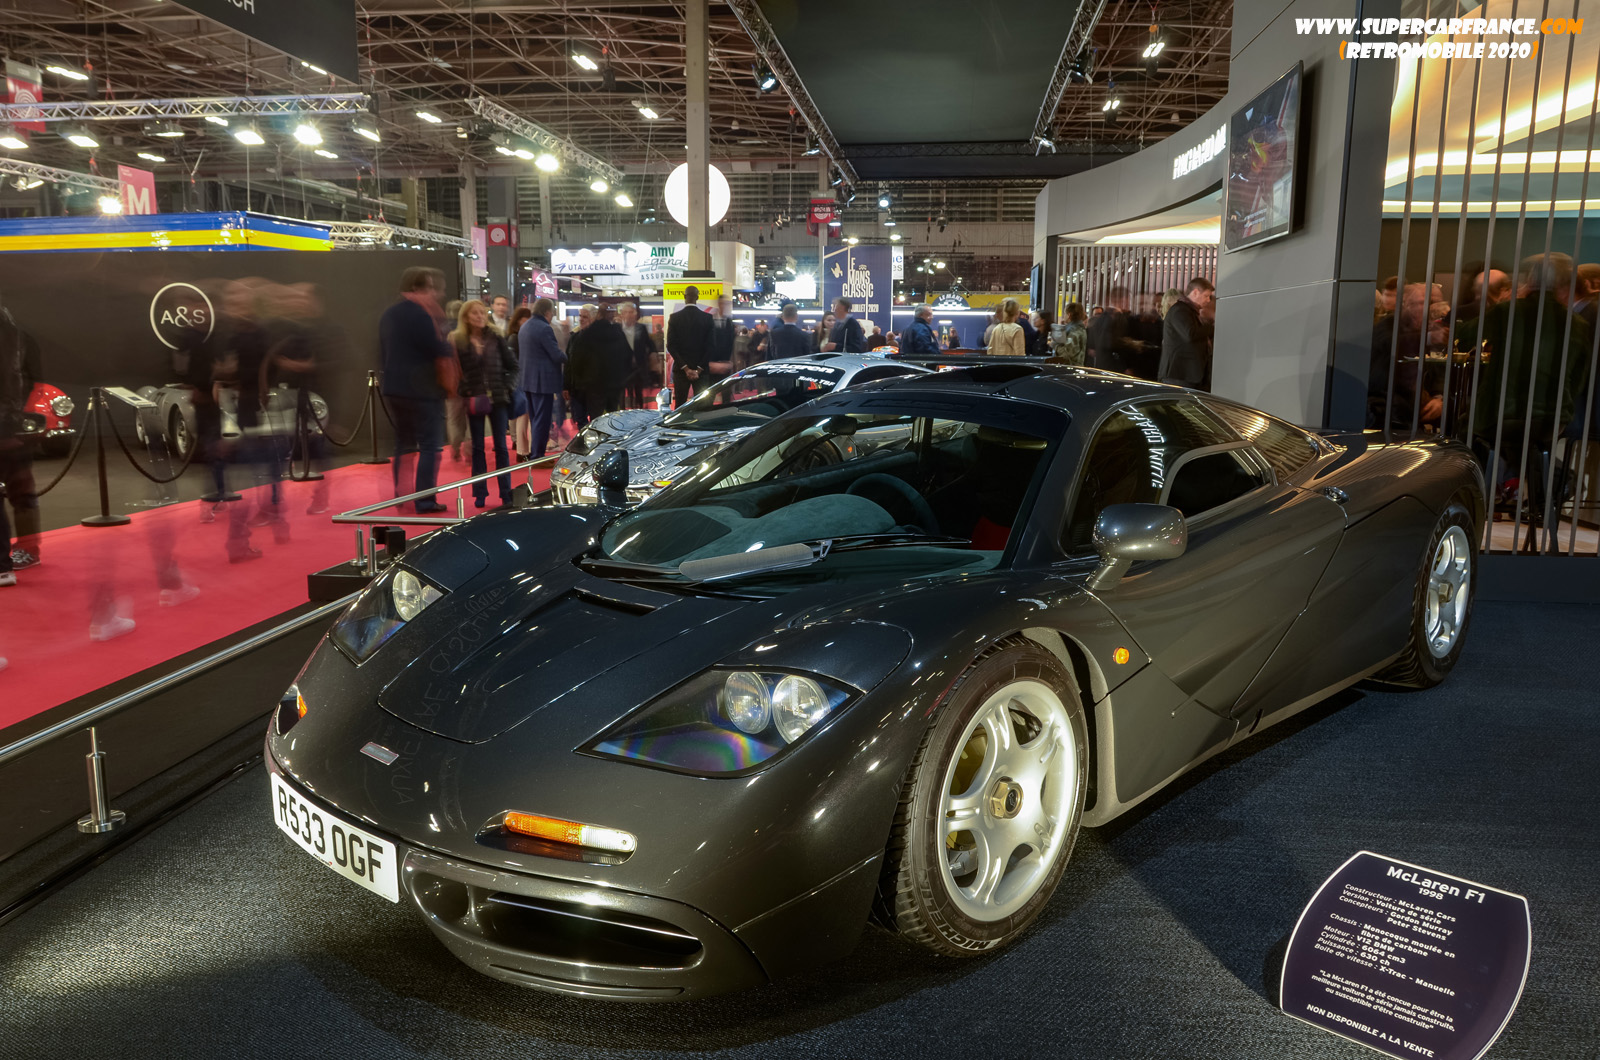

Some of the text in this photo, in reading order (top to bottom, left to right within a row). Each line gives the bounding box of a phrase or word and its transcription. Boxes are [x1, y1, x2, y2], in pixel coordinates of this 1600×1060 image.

[127, 184, 151, 215] M
[568, 263, 616, 271] UTAC CERAM
[641, 272, 683, 281] ASSURANC
[848, 270, 871, 285] MANS
[842, 283, 874, 298] CLASSIC
[160, 306, 205, 327] A&S
[277, 784, 384, 883] R533 OGF
[1386, 866, 1486, 904] McLaren F1
[1418, 887, 1444, 901] 1998
[919, 868, 992, 950] MICHELI
[1339, 895, 1384, 914] Concepteurs
[1390, 911, 1420, 925] Gordon
[1421, 921, 1453, 936] Murray
[1342, 890, 1370, 902] Version
[1376, 900, 1406, 914] Voiture
[1407, 909, 1418, 918] de
[1420, 912, 1442, 925] série
[1344, 884, 1393, 902] Constructeur
[1398, 900, 1434, 916] McLaren
[1436, 911, 1457, 923] Cars
[1323, 925, 1350, 937] Moteur
[1356, 935, 1372, 945] V12
[1373, 941, 1396, 953] BMW
[1330, 913, 1358, 926] Chassis
[1363, 923, 1409, 943] Monocoque
[1411, 939, 1443, 954] moulée
[1444, 950, 1456, 959] en
[1360, 929, 1429, 957] fibre de carbone
[1386, 917, 1447, 941] Peter Stevens
[1317, 937, 1354, 954] Puissance
[1360, 951, 1378, 961] 630
[1380, 958, 1391, 966] ch
[1320, 931, 1356, 947] Cylindrée
[1361, 945, 1385, 957] 6064
[1387, 954, 1406, 964] cm3
[1335, 950, 1345, 958] de
[1346, 954, 1373, 968] vitesse
[1379, 965, 1407, 980] X-Trac
[1415, 978, 1456, 997] Manuelle
[1311, 974, 1341, 989] meilleure
[1342, 985, 1365, 998] voiture
[1366, 993, 1375, 1002] de
[1375, 997, 1393, 1009] série
[1393, 1004, 1417, 1018] jamais
[1332, 974, 1360, 989] McLaren
[1360, 984, 1368, 992] F1
[1374, 989, 1387, 998] été
[1411, 1003, 1429, 1014] pour
[1429, 1009, 1445, 1020] être
[1446, 1015, 1453, 1023] la
[1335, 990, 1372, 1009] susceptible
[1372, 1004, 1394, 1016] d'être
[1306, 1003, 1435, 1058] NON DISPONIBLE A LA VENTE
